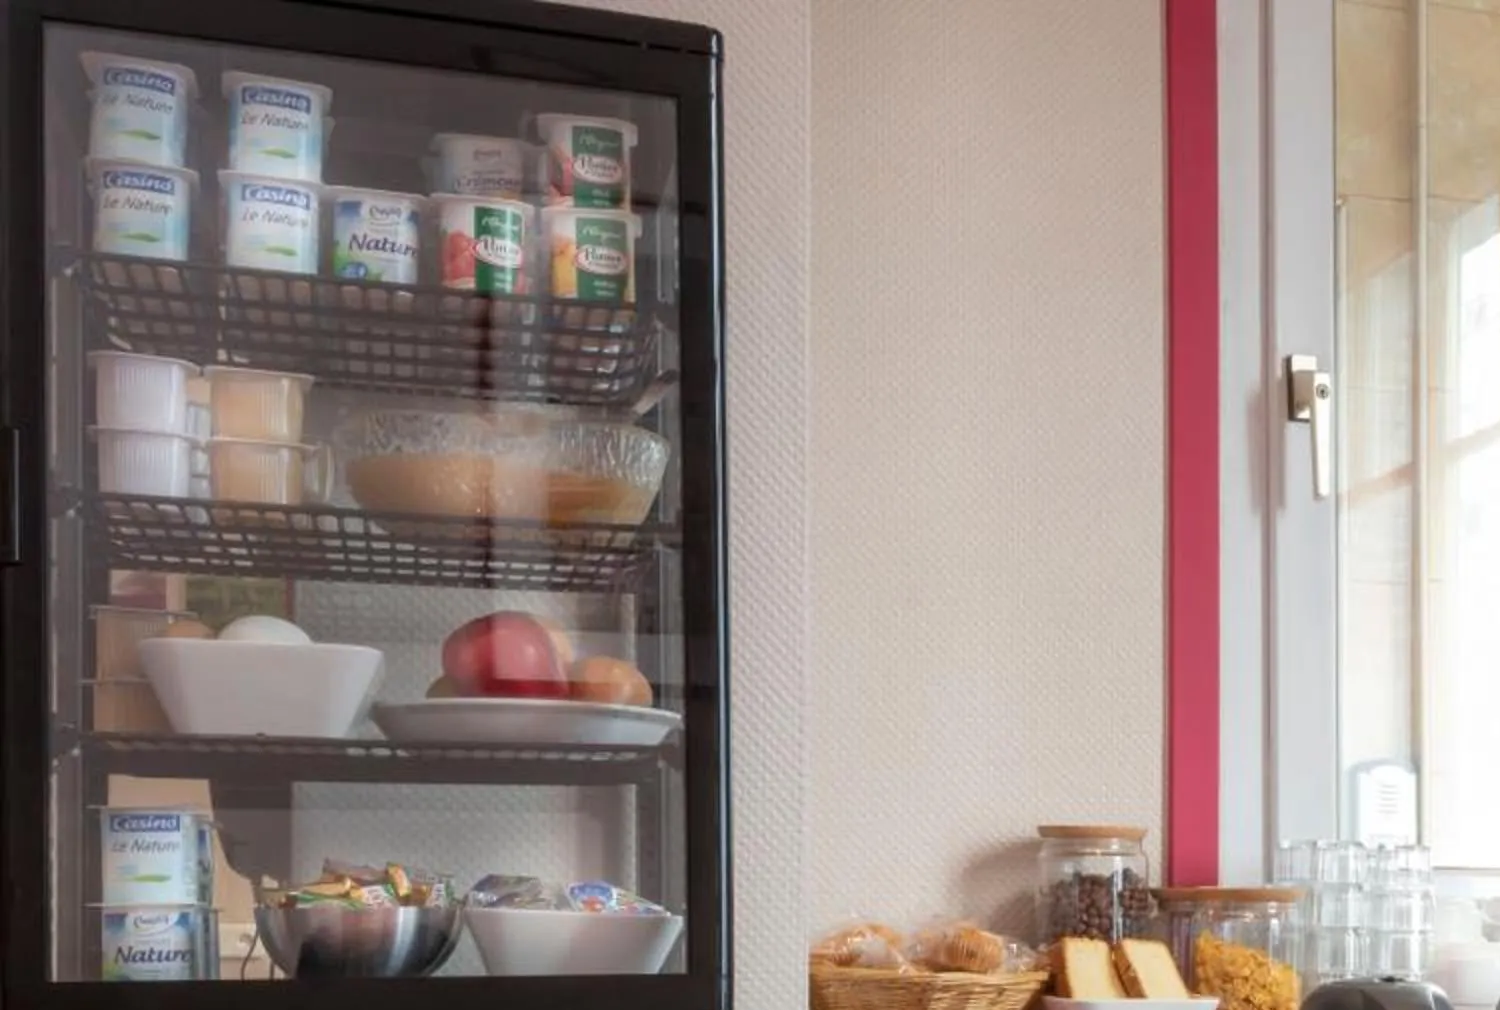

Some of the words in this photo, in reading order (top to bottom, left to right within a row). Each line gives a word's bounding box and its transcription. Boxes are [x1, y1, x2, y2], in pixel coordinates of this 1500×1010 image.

[106, 171, 173, 192] Casino
[245, 185, 307, 207] Casino
[348, 232, 418, 258] Natur
[113, 815, 178, 831] Casino
[115, 945, 193, 965] Nature
